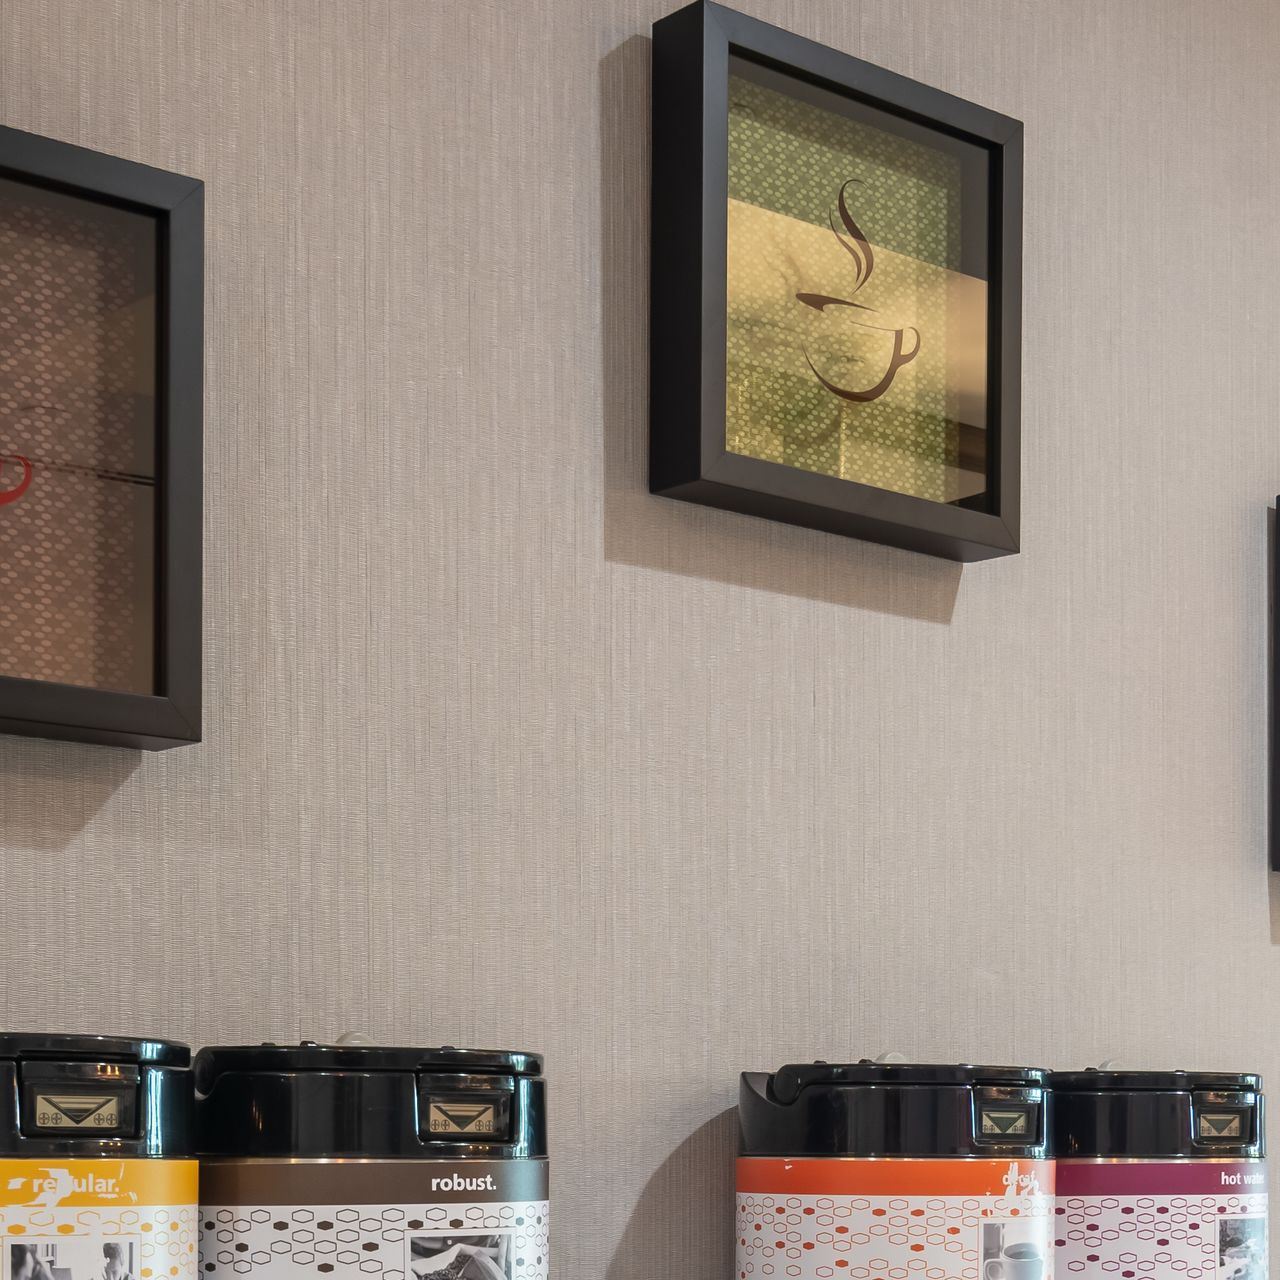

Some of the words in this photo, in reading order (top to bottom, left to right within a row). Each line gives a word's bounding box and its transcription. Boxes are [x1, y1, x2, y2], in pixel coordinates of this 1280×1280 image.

[32, 1172, 120, 1193] reular.
[431, 1173, 497, 1192] robust.
[1221, 1171, 1242, 1185] hot
